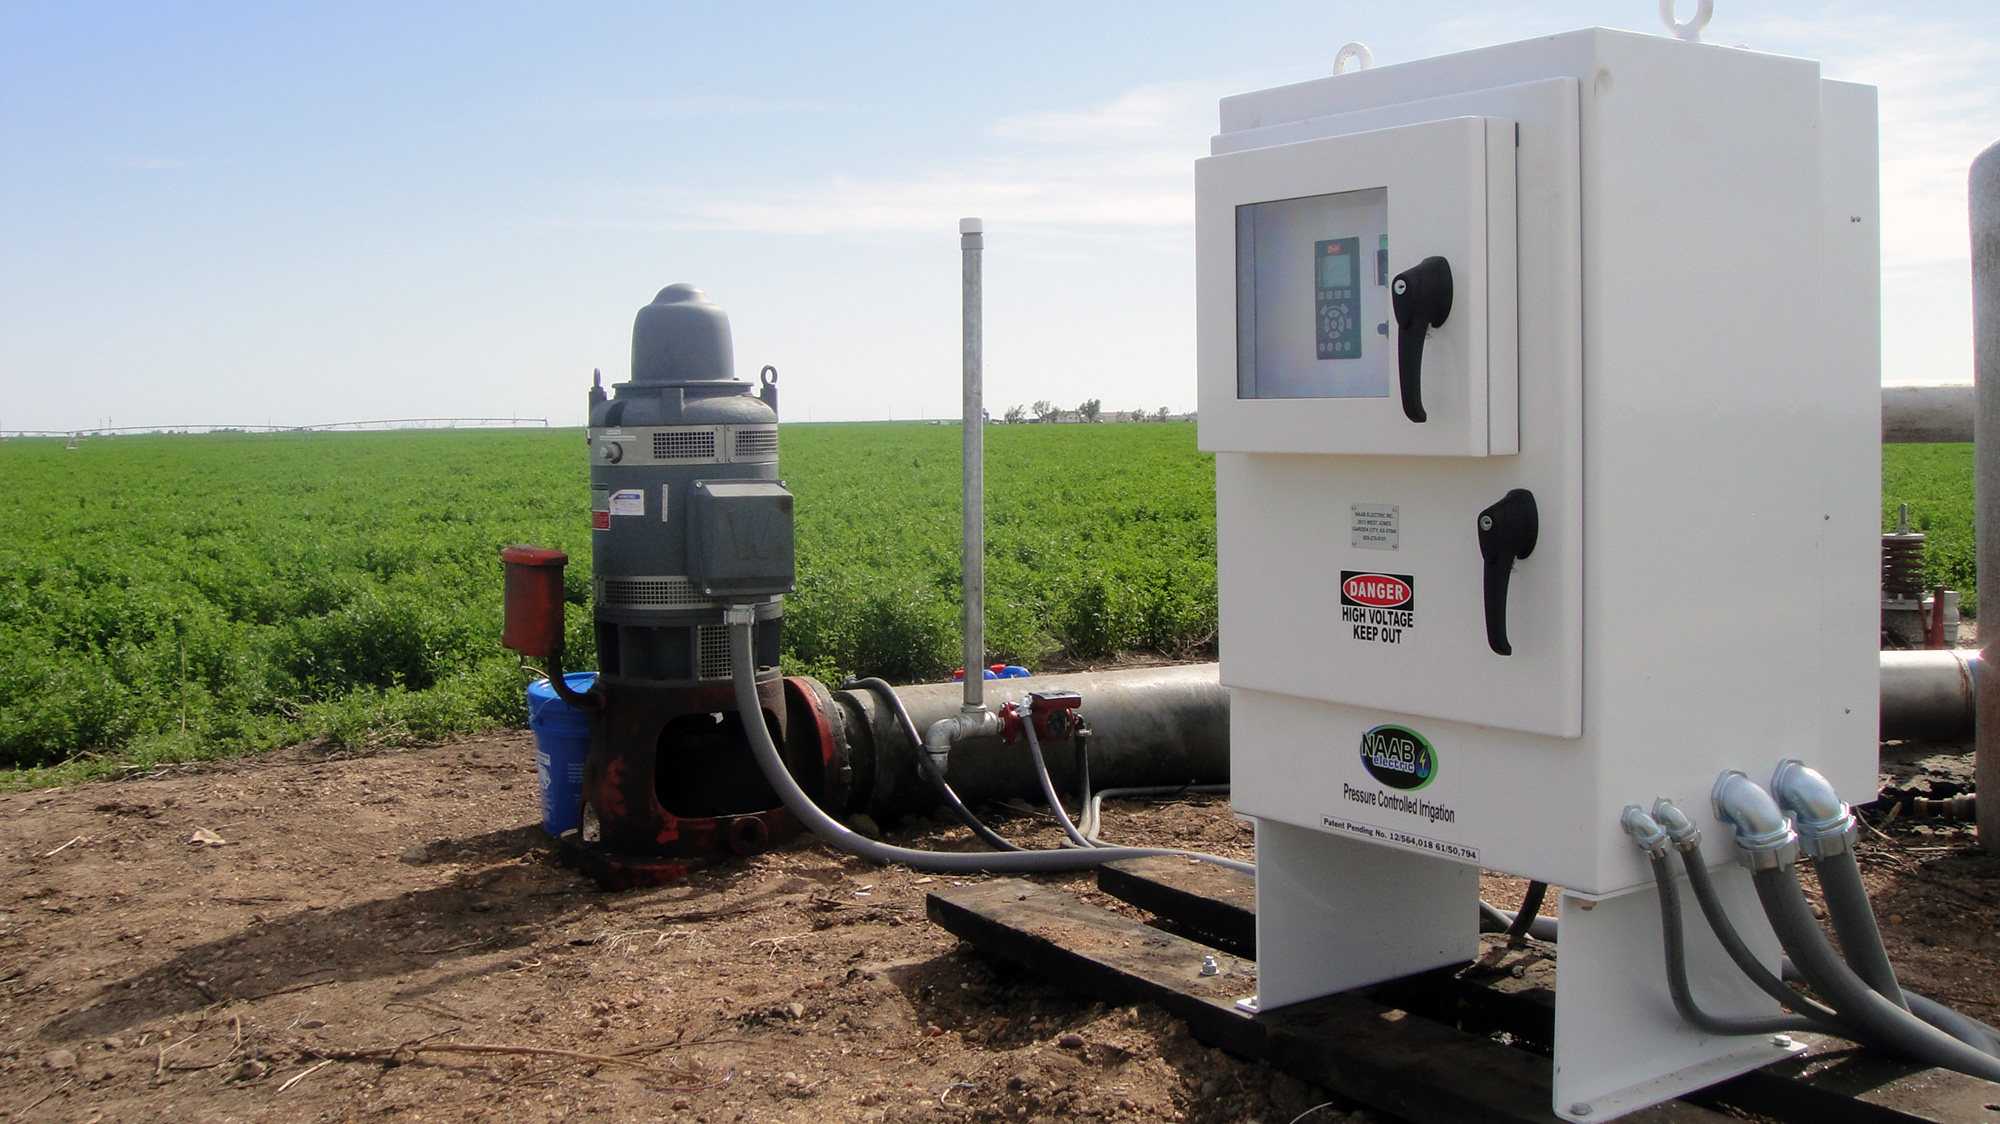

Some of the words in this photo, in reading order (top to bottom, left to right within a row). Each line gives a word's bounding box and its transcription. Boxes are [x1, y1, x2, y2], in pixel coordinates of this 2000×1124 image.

[1350, 581, 1403, 600] DANGER
[1342, 606, 1366, 623] HIGH
[1369, 609, 1413, 628] VOLTAGE
[1353, 624, 1378, 641] KEEP
[1381, 627, 1402, 644] OUT
[1362, 732, 1415, 763] NAAB
[1373, 755, 1415, 773] electric
[1343, 783, 1376, 806] Pressure
[1378, 790, 1417, 815] Controlled
[1419, 799, 1455, 823] Irrigation
[1323, 818, 1345, 830] Patent
[1346, 823, 1373, 836] Pending
[1375, 829, 1387, 839] No.
[1390, 832, 1433, 849] 12/564,018
[1435, 843, 1476, 859] 61/50,794
